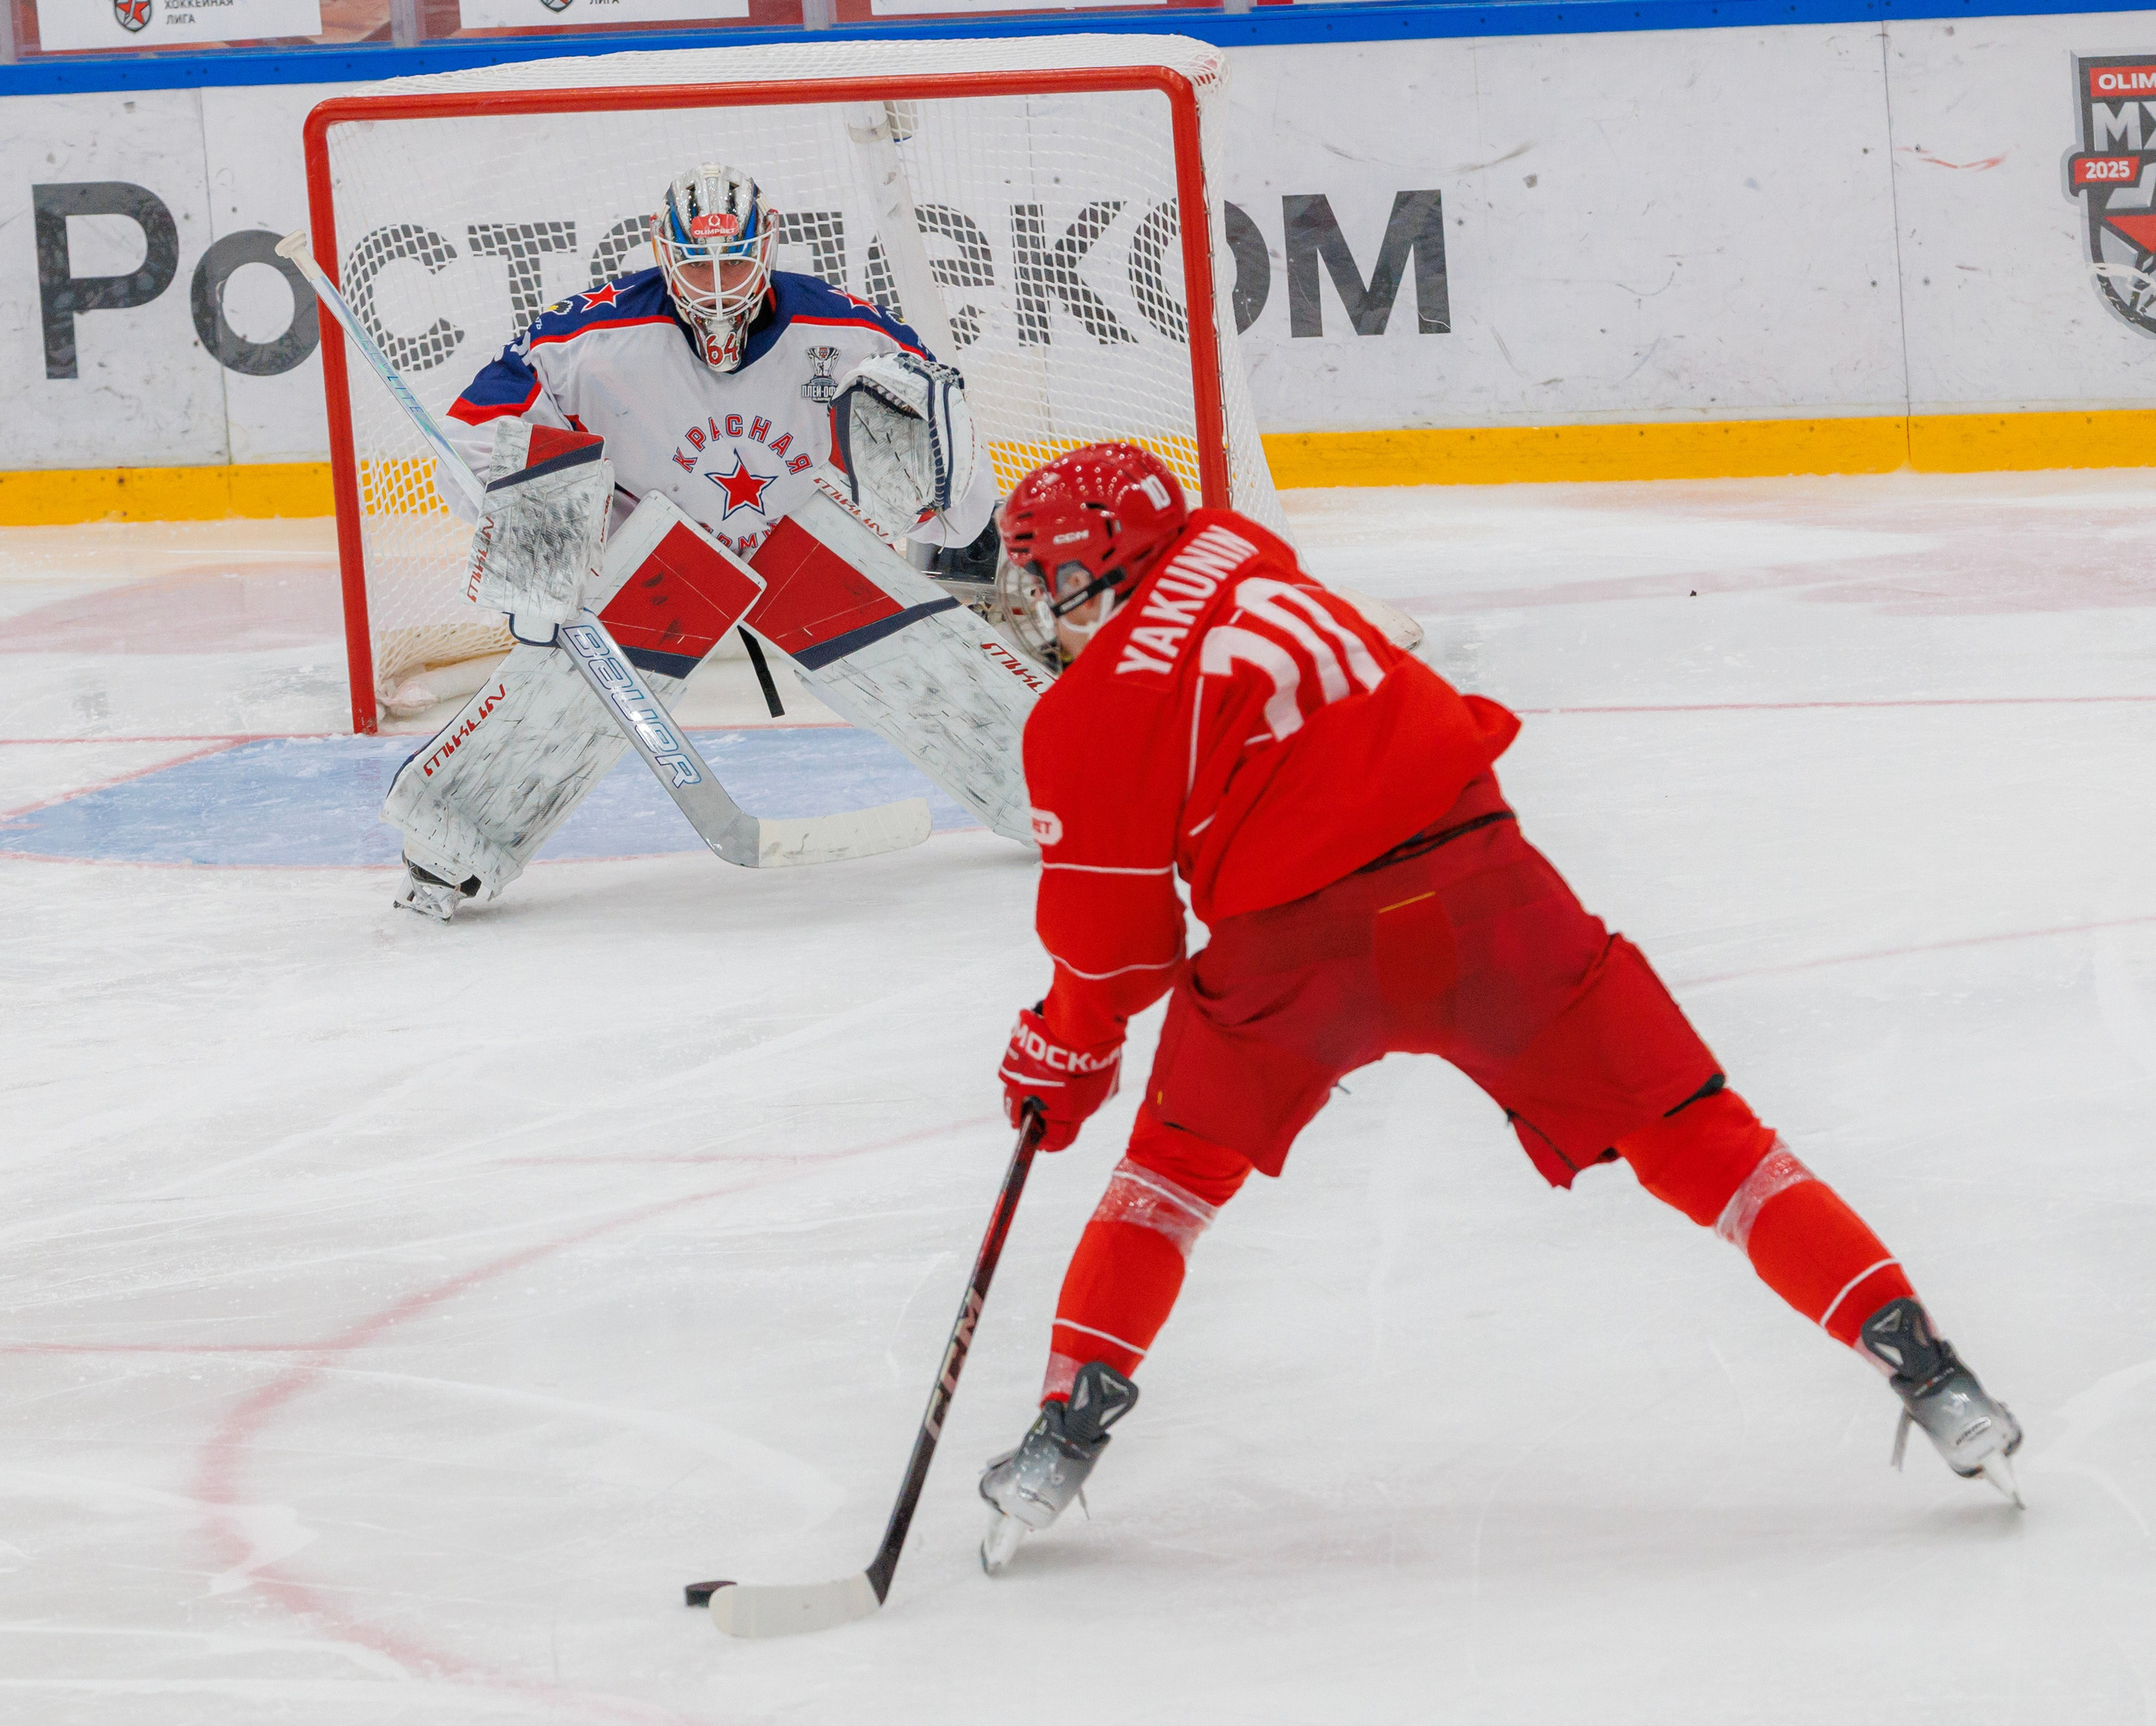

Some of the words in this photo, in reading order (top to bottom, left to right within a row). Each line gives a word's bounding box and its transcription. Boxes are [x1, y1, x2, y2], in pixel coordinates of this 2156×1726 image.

[167, 13, 195, 24] ЛИГА
[2085, 161, 2131, 179] 2025
[693, 227, 736, 236] OLIMPBET
[705, 331, 739, 367] 64
[802, 384, 837, 397] ПЛЕЙ-ОФ
[672, 413, 814, 476] КРАСНАЯ
[1139, 473, 1172, 512] 10
[1114, 523, 1260, 674] YAKUNIN
[979, 642, 1045, 697] MIKL
[1198, 576, 1387, 743] 10
